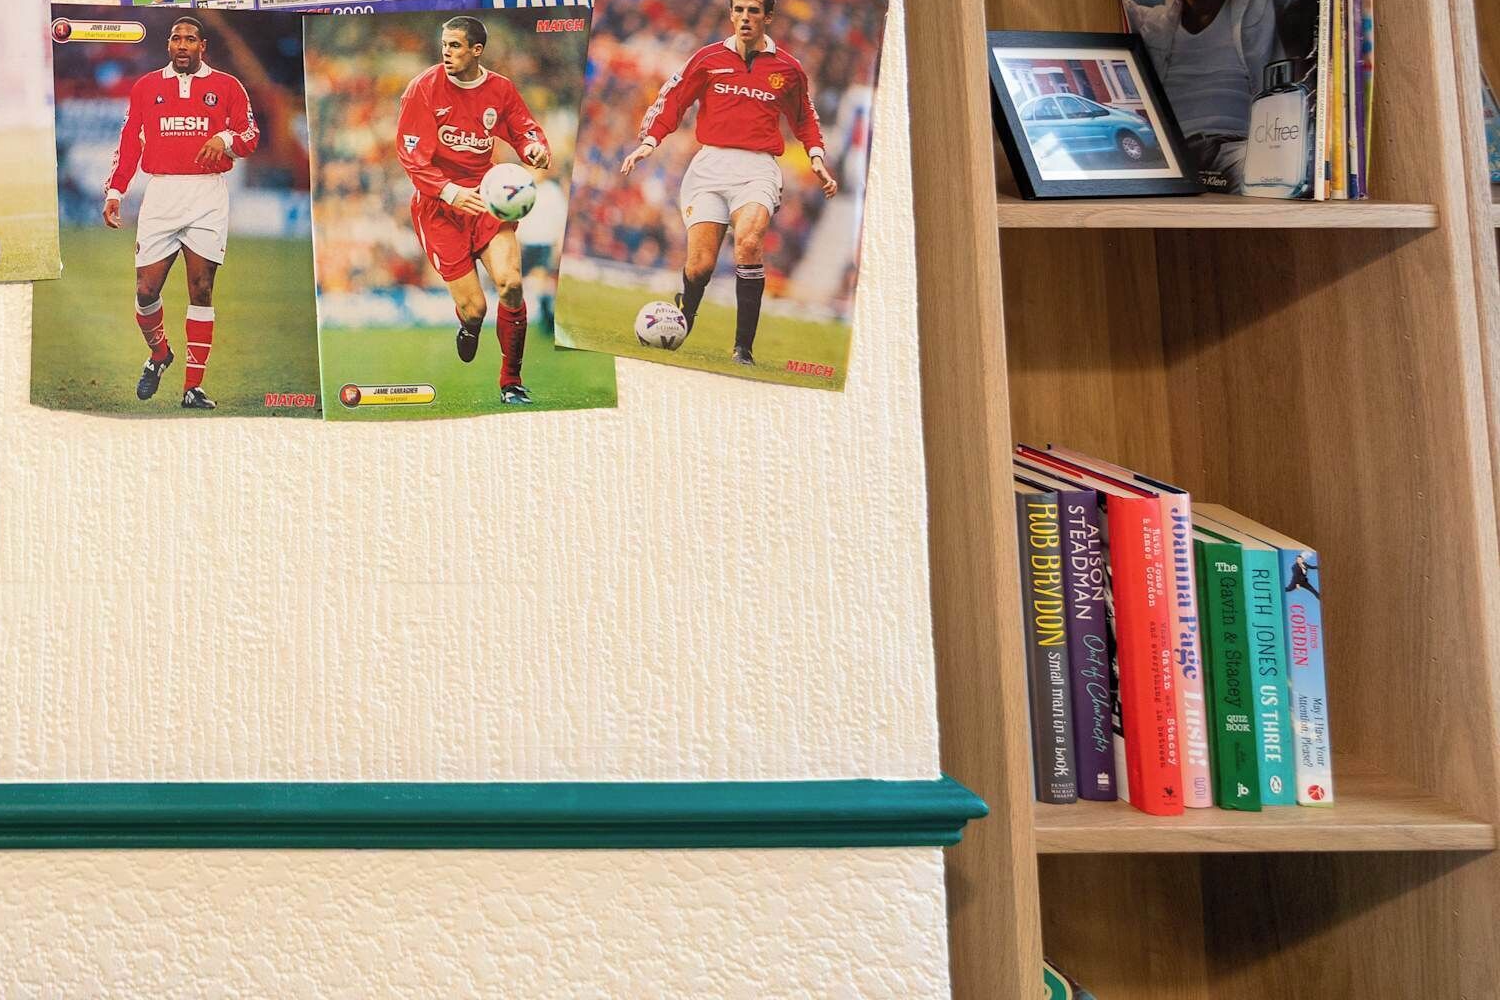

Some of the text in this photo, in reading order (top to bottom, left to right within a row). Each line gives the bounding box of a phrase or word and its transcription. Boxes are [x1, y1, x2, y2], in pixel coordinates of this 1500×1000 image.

[536, 18, 585, 33] MATCH
[714, 82, 776, 102] SHARP
[160, 116, 210, 131] MESH
[1206, 176, 1227, 187] Klein
[785, 359, 835, 378] MATCH
[265, 393, 315, 408] MATCH
[1068, 504, 1092, 621] STEADMAN
[1085, 524, 1104, 601] ALISON
[1152, 528, 1164, 595] Ruth Jones
[1215, 562, 1238, 573] The
[1028, 503, 1069, 778] ROB BRYDON small man in a book
[1083, 634, 1105, 663] Out
[1171, 507, 1206, 766] Joanna Page Lush!
[1222, 577, 1242, 709] Gavin & Stacey
[1289, 604, 1310, 667] CORDEN
[1306, 623, 1318, 649] James
[1162, 650, 1172, 690] Gavin
[1252, 569, 1282, 763] RUTH JONES US THREE
[1086, 682, 1110, 753] Character
[1226, 714, 1249, 723] QUIZ
[1310, 697, 1323, 715] May
[1225, 723, 1250, 732] BOOK
[1313, 723, 1325, 745] Have
[1166, 718, 1177, 765] Stacey
[1301, 737, 1313, 768] Please?
[1315, 746, 1326, 766] Your
